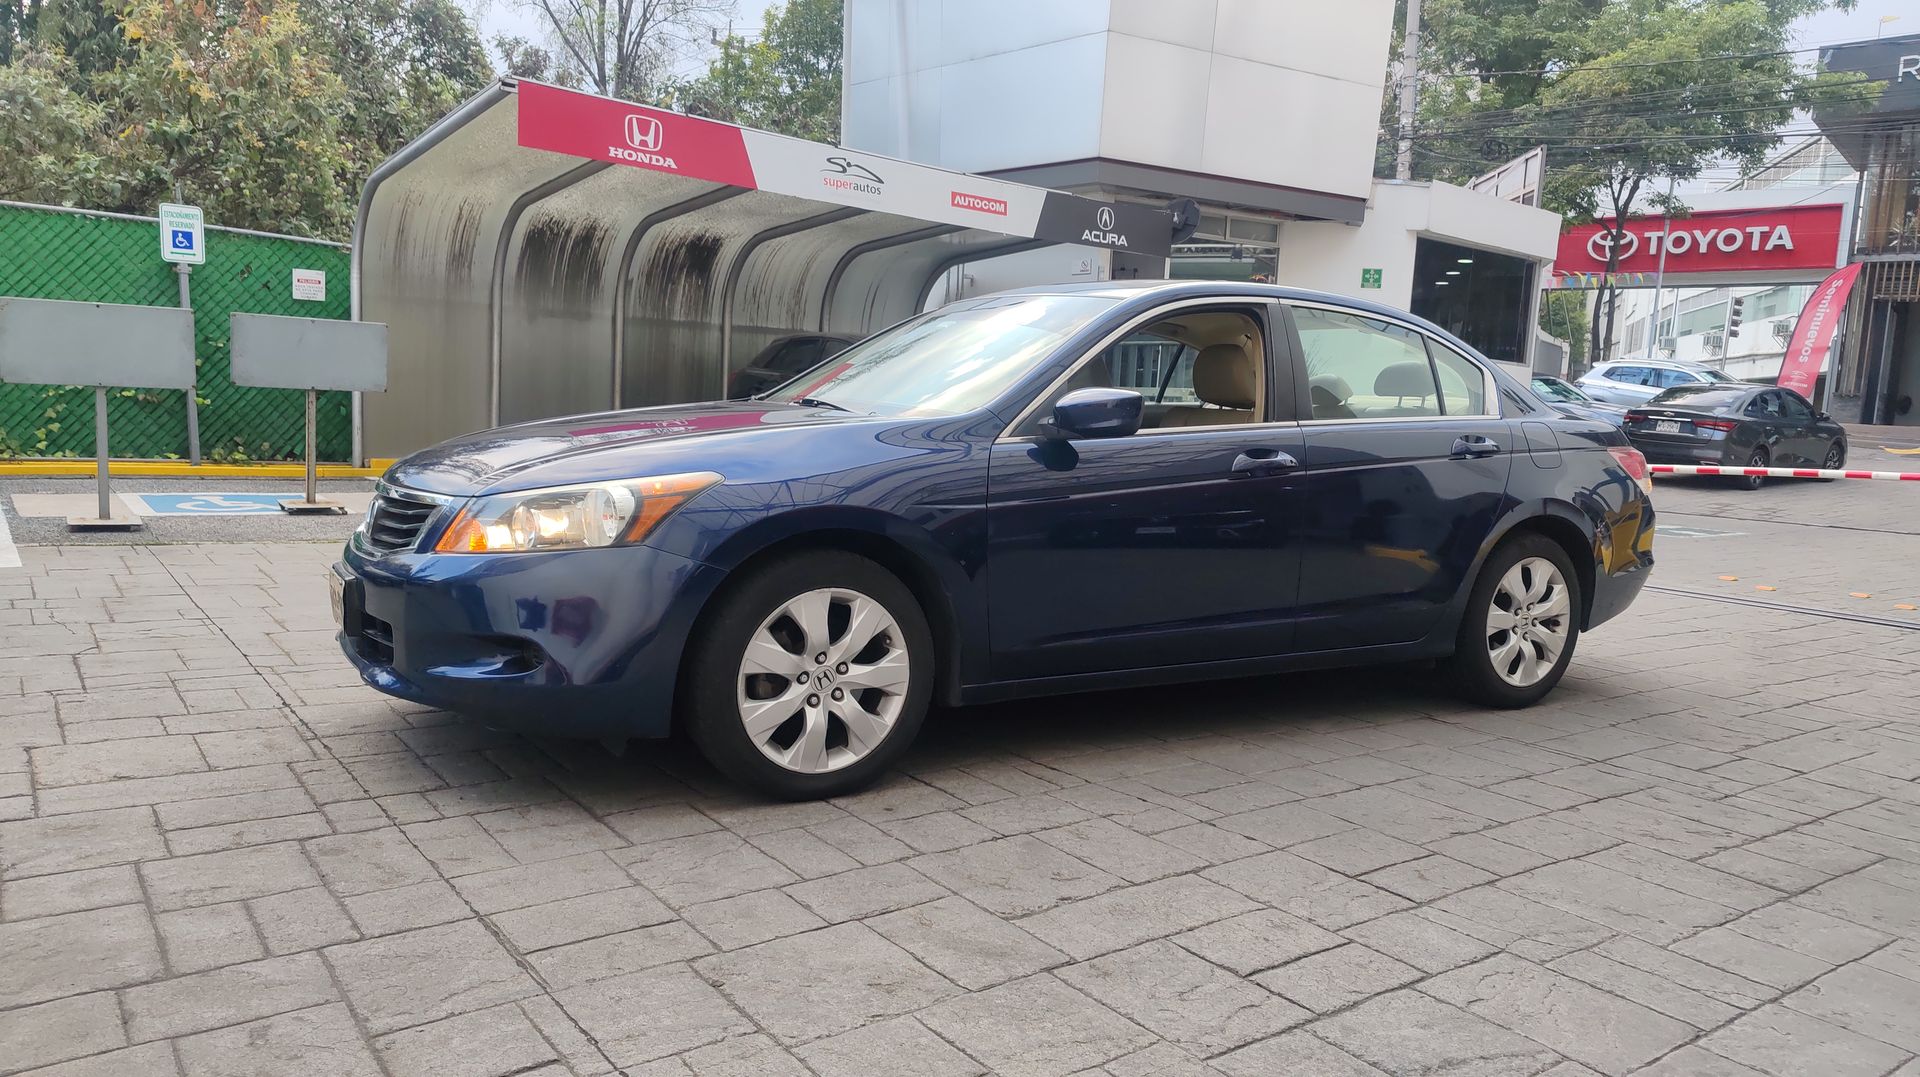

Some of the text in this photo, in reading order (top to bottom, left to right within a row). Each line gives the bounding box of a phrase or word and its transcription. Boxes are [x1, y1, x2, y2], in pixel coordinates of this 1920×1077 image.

[608, 146, 678, 169] HONDA
[823, 177, 882, 195] superautos
[954, 195, 1005, 213] AUTOCOM
[1081, 229, 1128, 247] ACURA
[1644, 225, 1794, 255] TOYOTA
[1799, 279, 1844, 364] Seminuevos
